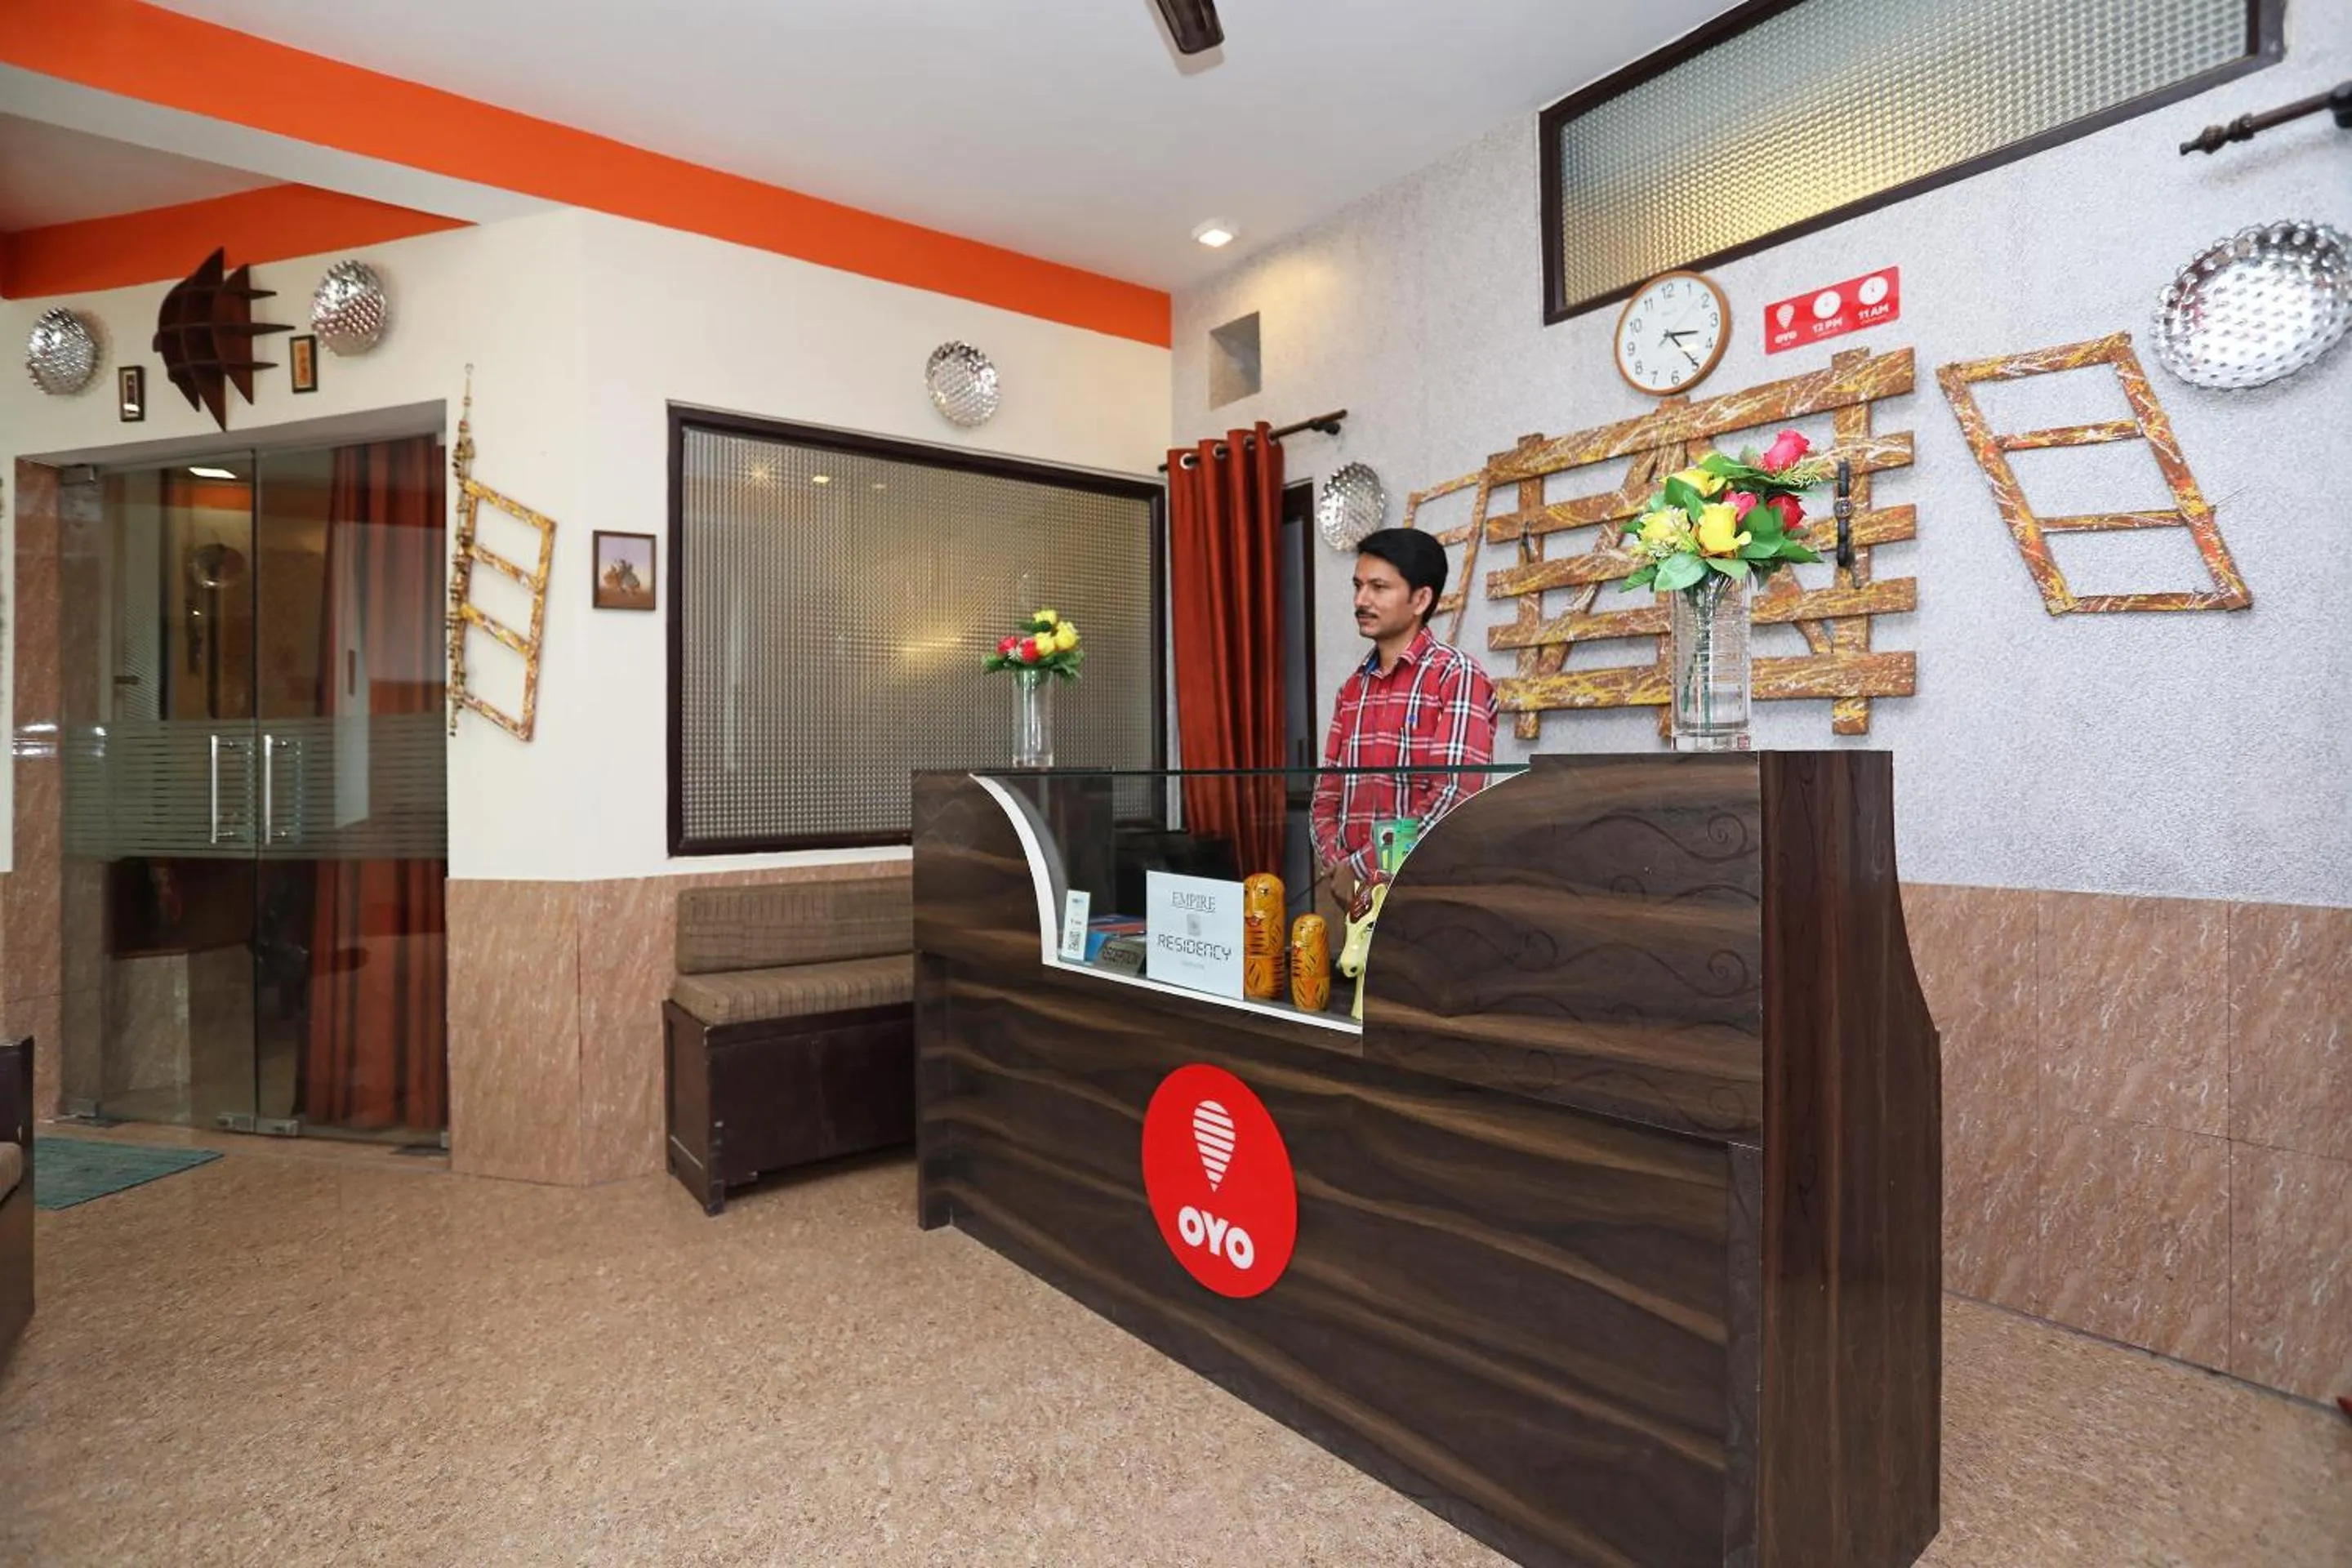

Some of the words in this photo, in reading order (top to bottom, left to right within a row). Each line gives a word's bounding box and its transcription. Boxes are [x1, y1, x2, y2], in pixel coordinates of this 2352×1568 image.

[1661, 283, 1675, 299] 12
[1686, 282, 1692, 296] 1
[1644, 297, 1654, 311] 11
[1700, 292, 1710, 309] 2
[1869, 303, 1889, 317] AM
[1629, 318, 1642, 334] 10
[1709, 312, 1718, 327] 3
[1812, 323, 1824, 333] 12
[1824, 317, 1843, 331] PM
[1705, 336, 1713, 350] 4
[1775, 331, 1797, 344] OYO
[1627, 341, 1636, 356] 9
[1635, 360, 1643, 376] 8
[1650, 370, 1659, 385] 7
[1671, 370, 1680, 385] 6
[1171, 891, 1216, 913] EMPIRE
[1157, 933, 1232, 961] RESIDENCY
[1178, 1205, 1255, 1270] OYO
